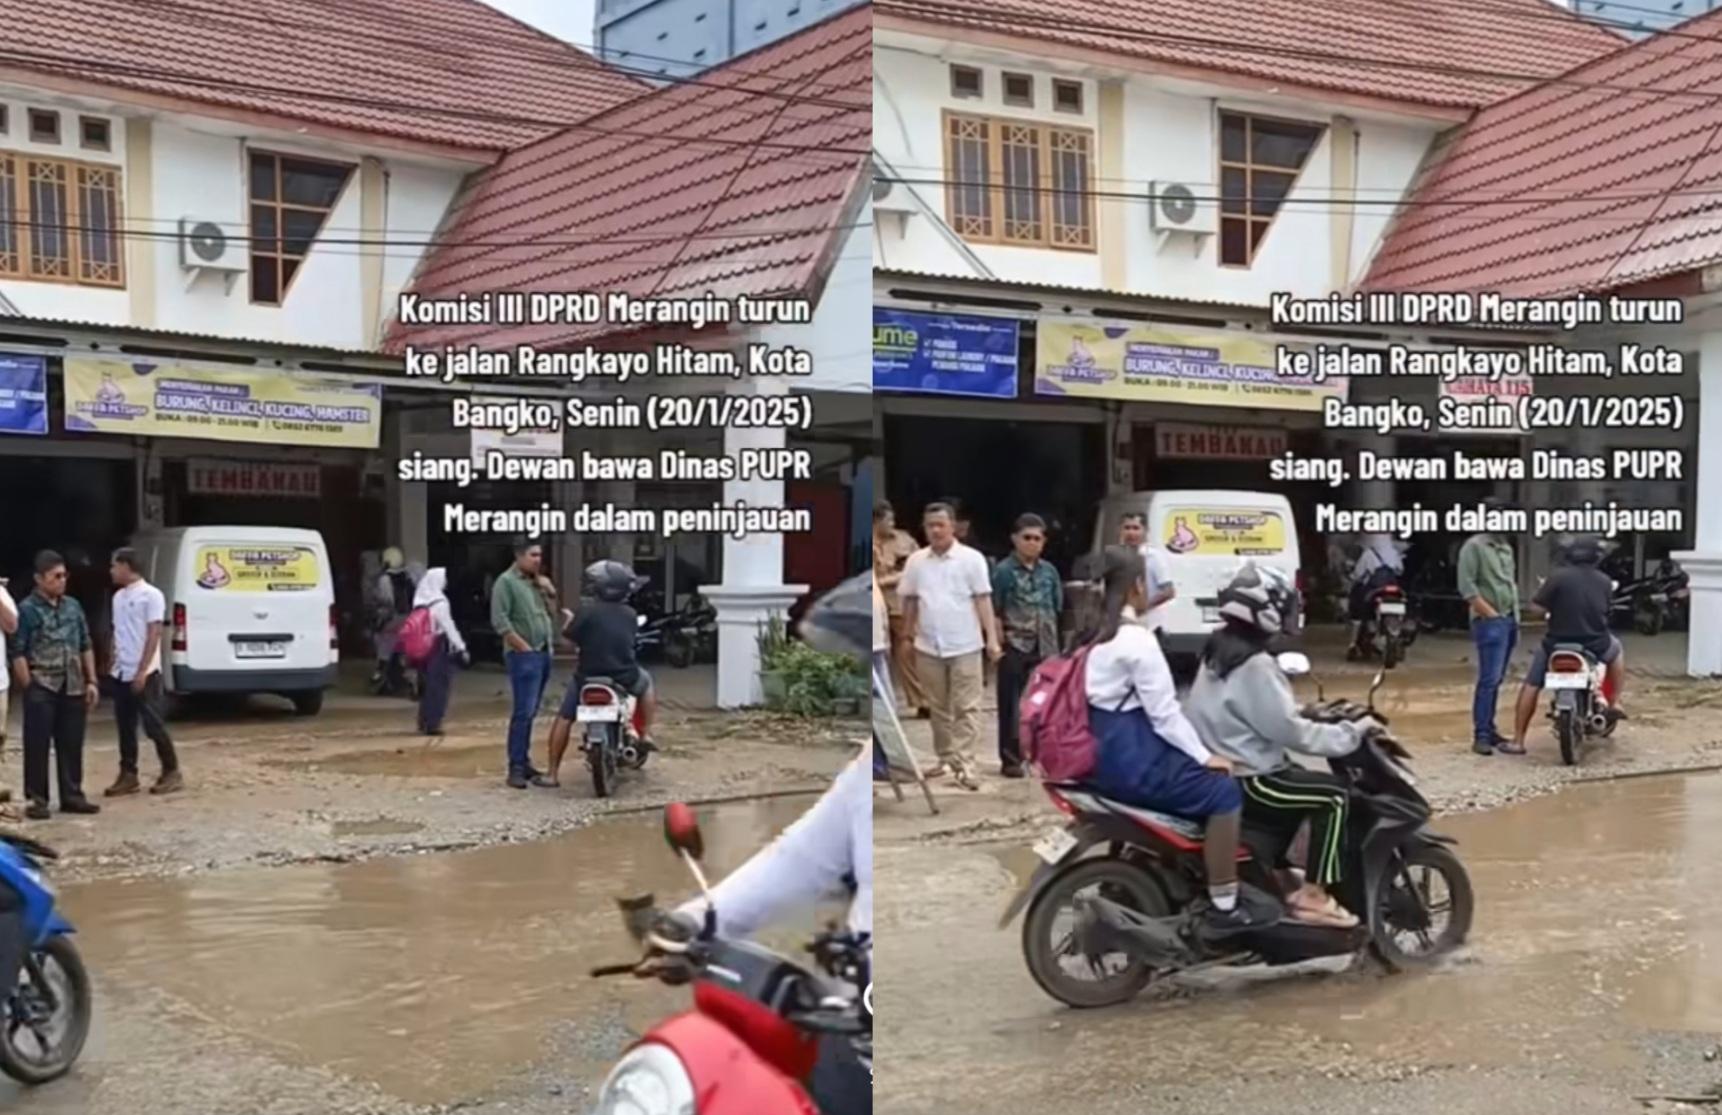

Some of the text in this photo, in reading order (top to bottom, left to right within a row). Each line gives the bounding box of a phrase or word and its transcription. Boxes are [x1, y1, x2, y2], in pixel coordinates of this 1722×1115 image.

[156, 394, 210, 411] BURUNG,
[265, 403, 313, 421] KUCING,
[316, 408, 369, 422] HAMSTER
[1162, 431, 1282, 457] TEMBAKAU
